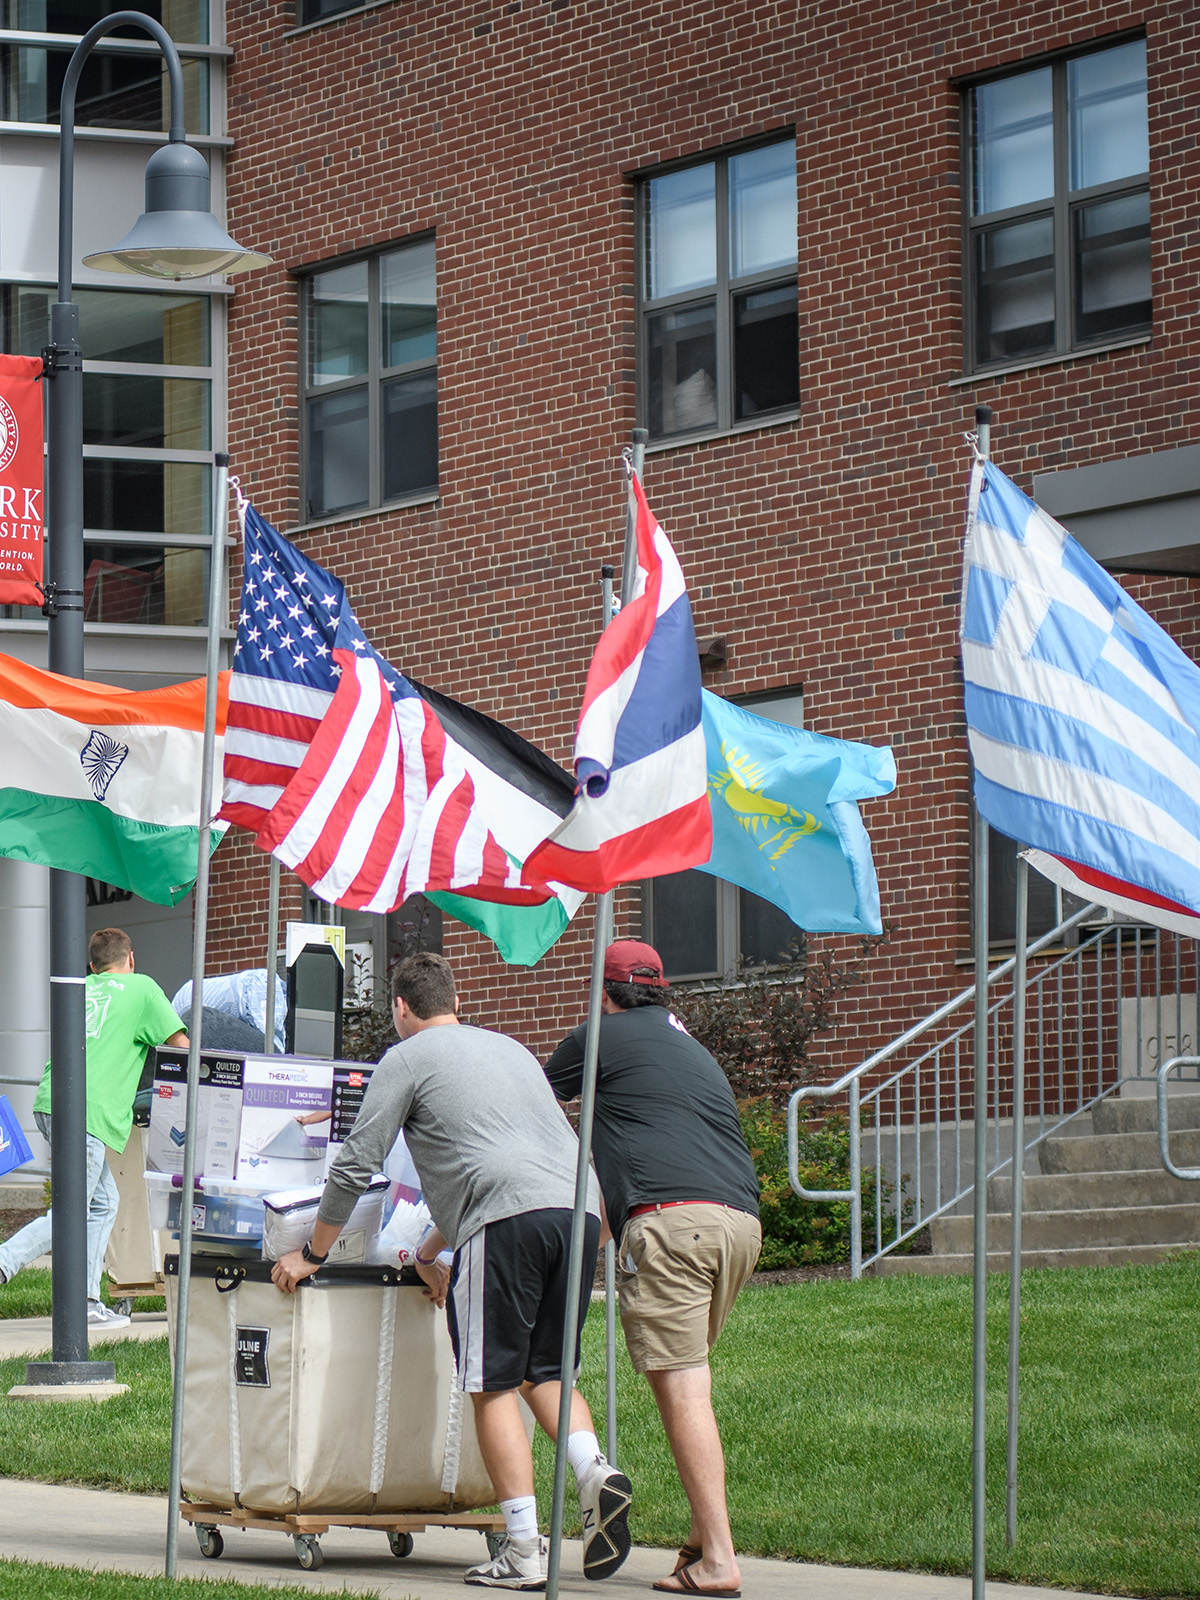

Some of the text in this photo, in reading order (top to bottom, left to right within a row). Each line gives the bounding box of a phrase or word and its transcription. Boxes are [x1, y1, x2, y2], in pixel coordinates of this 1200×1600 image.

[216, 1061, 240, 1073] QUILTED
[268, 1072, 308, 1082] THERAPEDIC
[245, 1087, 285, 1103] QUILTED
